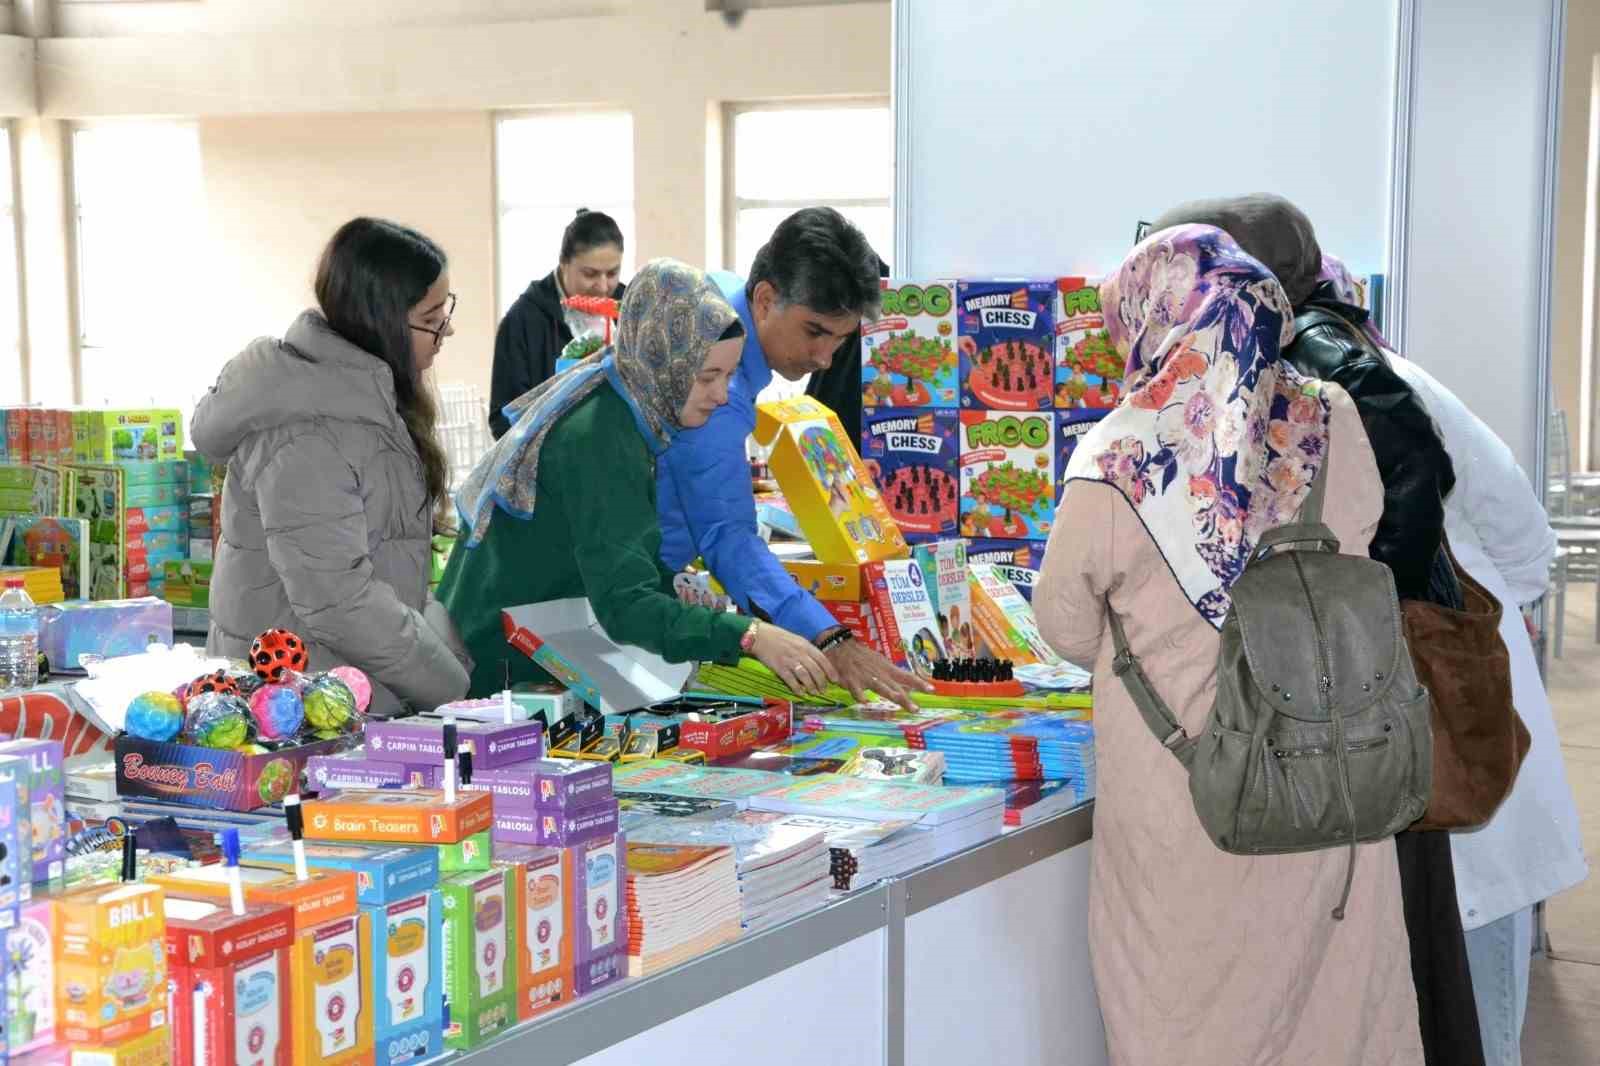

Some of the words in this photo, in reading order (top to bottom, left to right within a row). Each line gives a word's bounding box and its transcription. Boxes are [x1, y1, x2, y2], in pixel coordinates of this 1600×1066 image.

[880, 284, 952, 318] ROG
[965, 293, 1011, 312] MEMORY
[1063, 286, 1102, 317] FR
[985, 311, 1031, 326] CHESS
[870, 419, 918, 436] MEMORY
[966, 416, 1049, 449] FROG
[891, 435, 937, 451] CHESS
[968, 551, 1014, 565] MEMORY
[1003, 567, 1033, 584] ESS
[419, 743, 445, 754] TABLO
[31, 751, 53, 773] LL
[122, 753, 189, 793] Bouncy
[194, 762, 238, 792] Ball
[492, 785, 531, 796] TABLOSU
[333, 818, 366, 832] Brain
[369, 819, 419, 833] Teasers
[496, 821, 534, 832] TABLOSU
[109, 897, 154, 929] BALL
